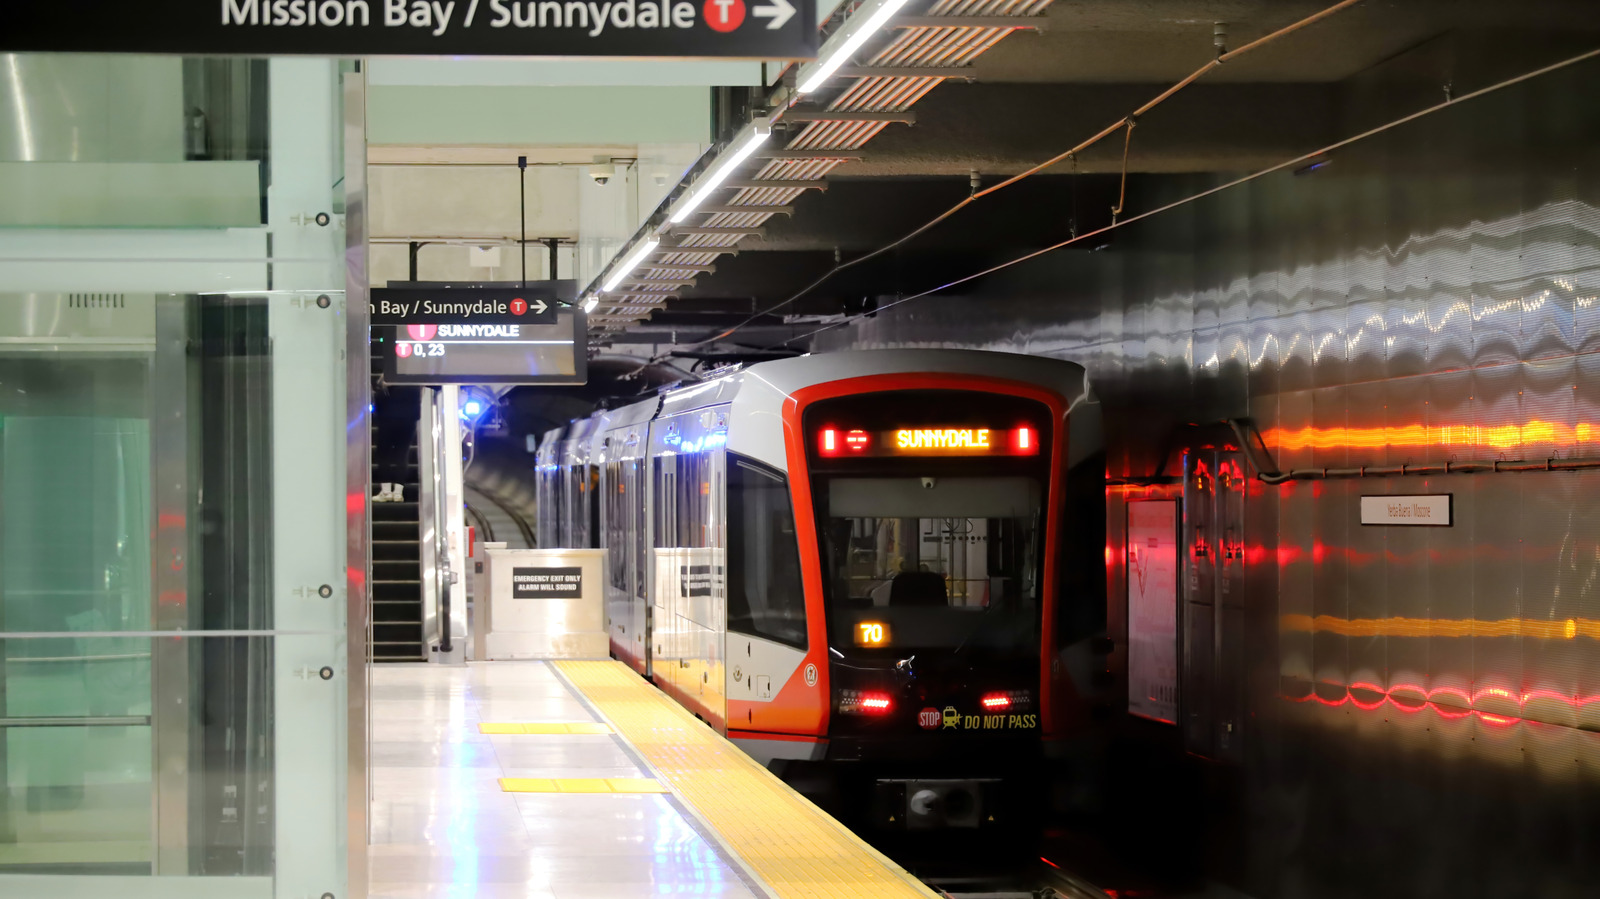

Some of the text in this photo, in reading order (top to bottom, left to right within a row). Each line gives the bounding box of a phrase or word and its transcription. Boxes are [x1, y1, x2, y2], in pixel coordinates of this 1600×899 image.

[221, 0, 370, 27] Mission
[384, 0, 455, 35] Bay
[490, 0, 695, 36] Sunnydale
[381, 300, 409, 318] Bay
[423, 300, 507, 317] Sunnydale
[437, 324, 520, 337] SUNNYDALE
[427, 343, 446, 357] 23
[897, 429, 989, 448] SUNNYDALE
[860, 624, 883, 643] 70
[920, 711, 940, 727] STOP
[964, 714, 1036, 729] DO NOT PASS
